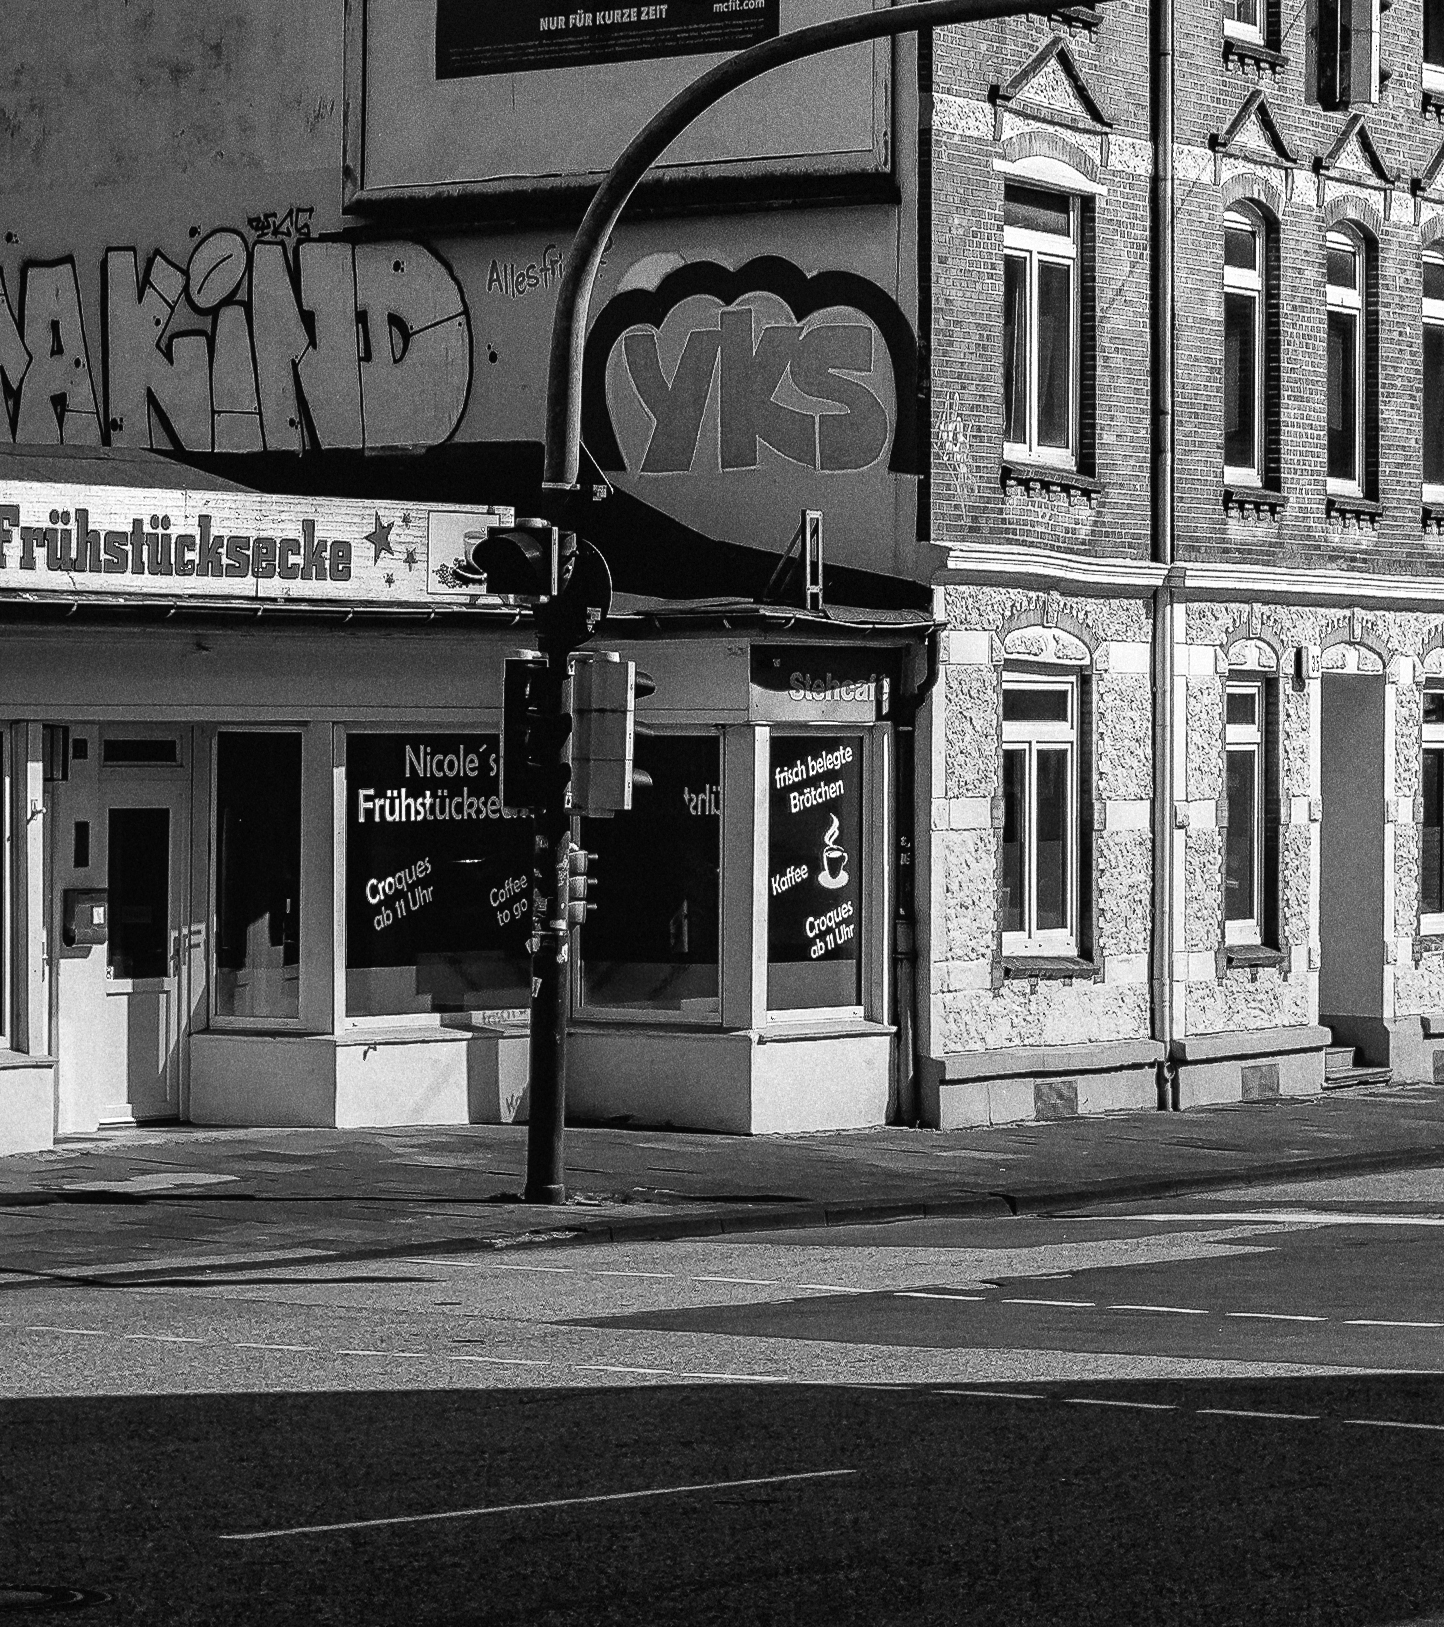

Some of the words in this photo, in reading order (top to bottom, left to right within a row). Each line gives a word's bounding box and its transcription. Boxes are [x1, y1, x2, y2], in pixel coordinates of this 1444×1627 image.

[539, 15, 565, 31] NUR
[569, 11, 593, 28] FÜR
[596, 7, 637, 26] KURZE
[640, 4, 668, 23] ZEIT
[774, 760, 806, 789] frisch
[808, 745, 853, 777] belegte
[358, 787, 535, 823] Frühstückse
[789, 779, 845, 813] Brötchen
[365, 856, 432, 904] Croques
[489, 875, 528, 907] Coffee
[771, 864, 808, 896] Kaffee
[373, 908, 393, 931] ab
[395, 901, 407, 918] 11
[408, 885, 434, 911] Uhr
[497, 909, 511, 926] to
[513, 898, 528, 919] go
[805, 900, 854, 939] Croques
[810, 941, 825, 959] ab
[826, 935, 835, 952] 11
[835, 923, 855, 947] Uhr
